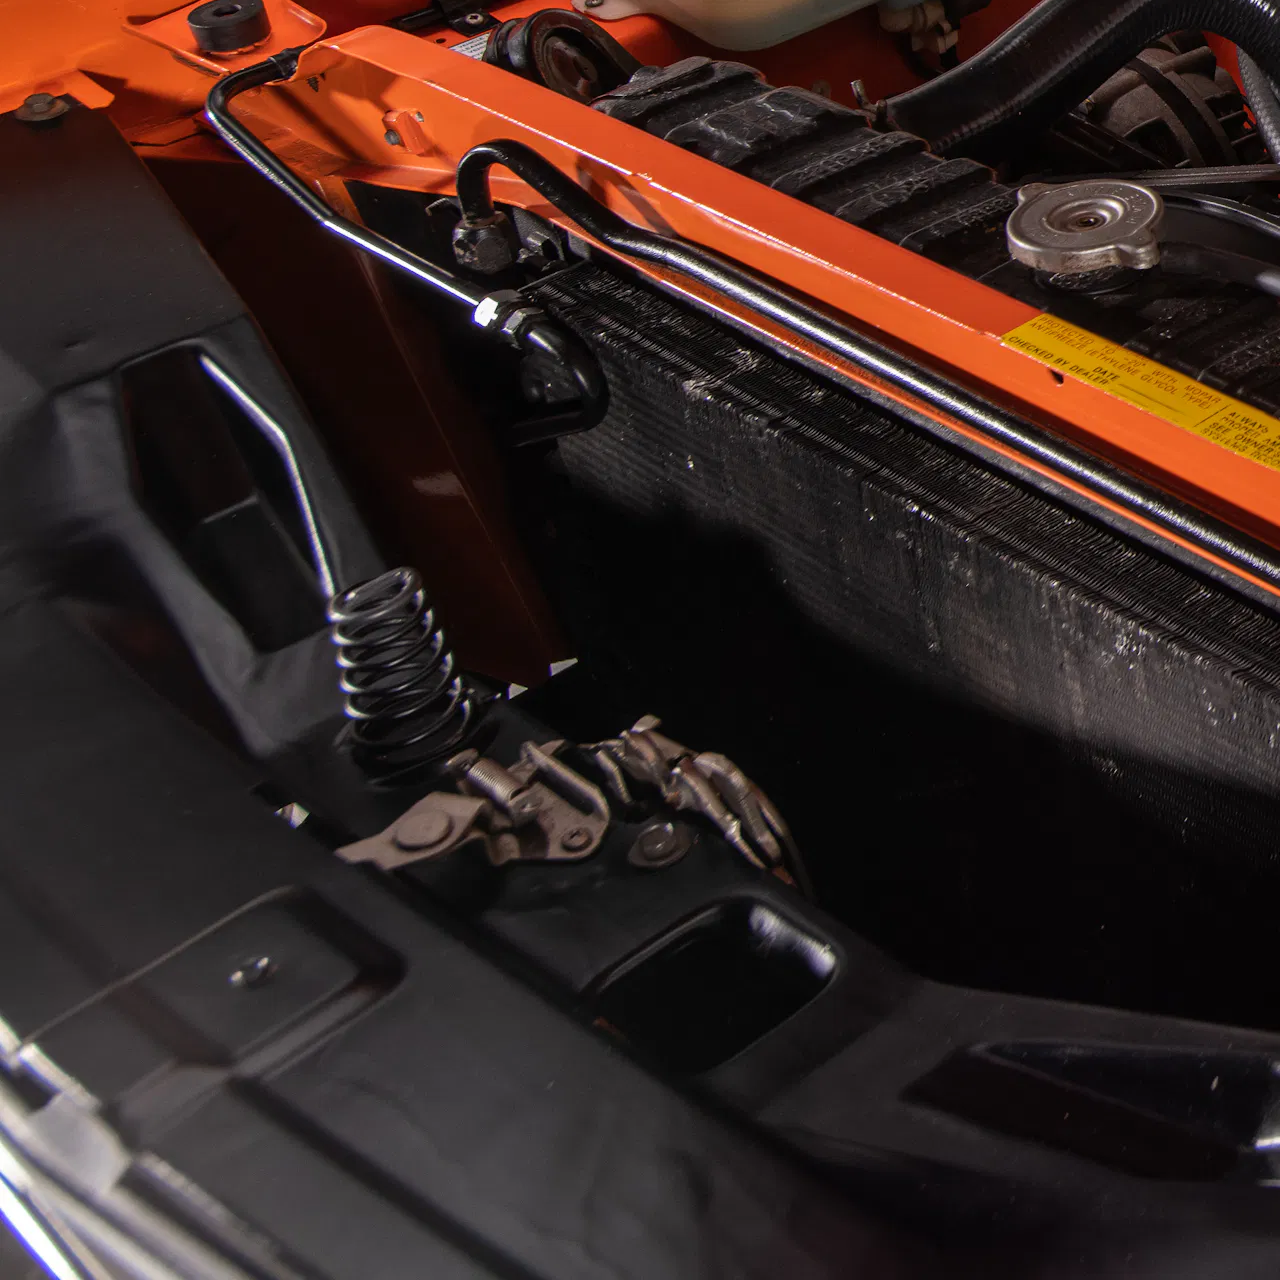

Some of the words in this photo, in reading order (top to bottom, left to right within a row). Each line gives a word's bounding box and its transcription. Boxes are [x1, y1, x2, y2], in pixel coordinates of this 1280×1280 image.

[1008, 336, 1053, 360] CHECKED
[1054, 357, 1069, 368] BY
[1069, 365, 1110, 385] DEALER
[1092, 367, 1120, 382] DATE
[1140, 374, 1178, 395] GLYCOL
[1152, 370, 1178, 384] WITH
[1184, 385, 1221, 404] MOPAR
[1209, 421, 1232, 434] SEE
[1228, 411, 1269, 433] ALWAYS
